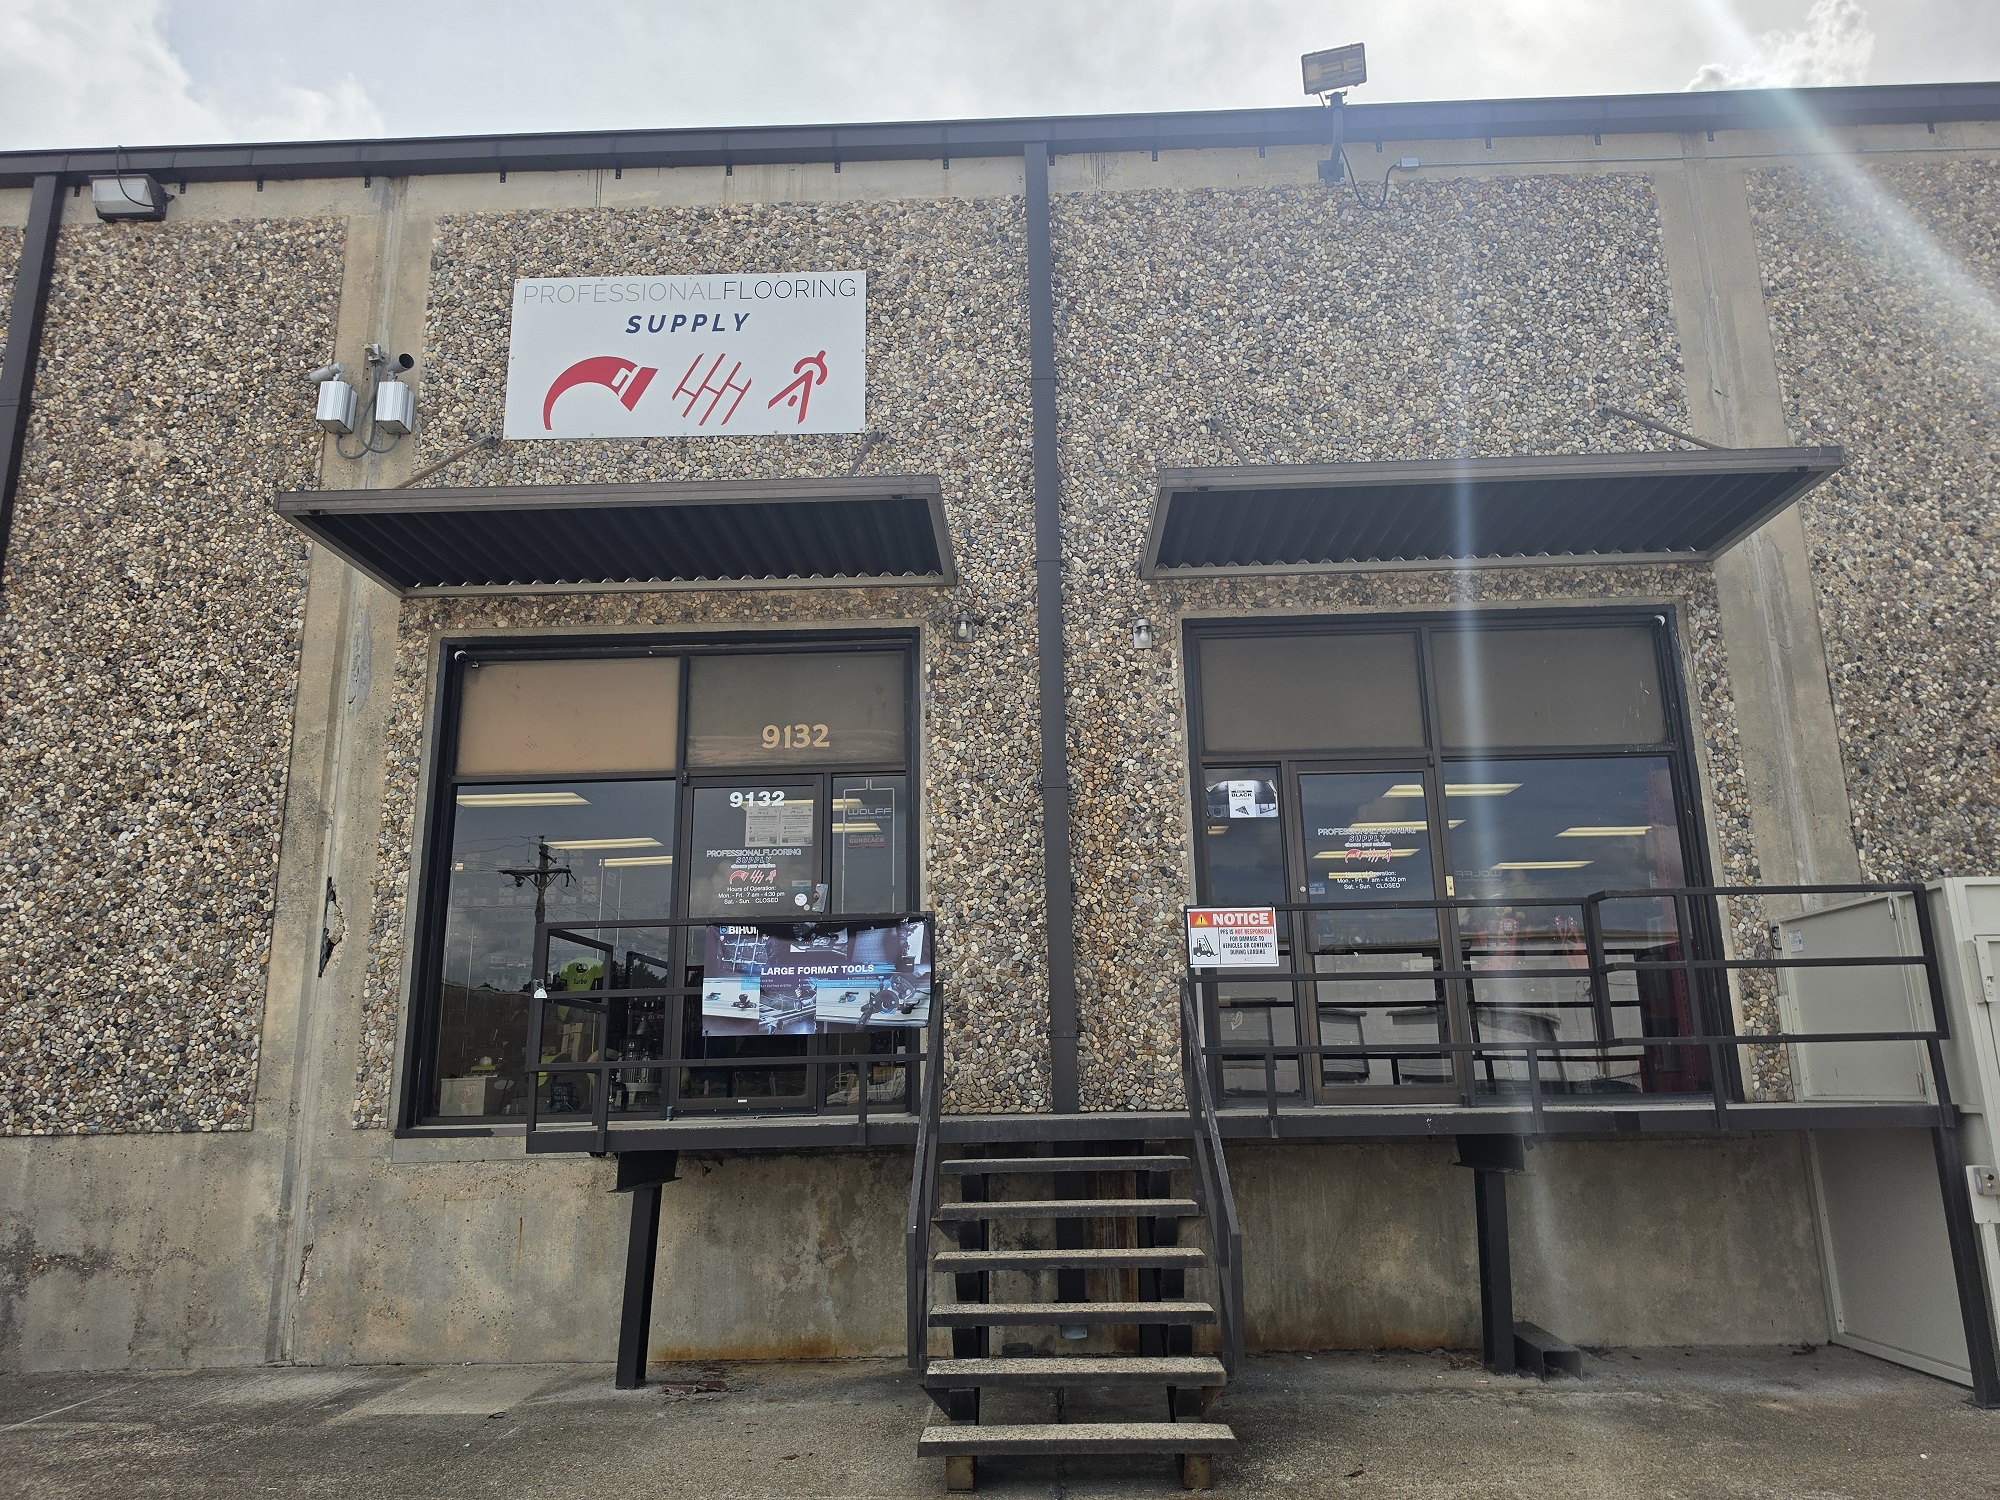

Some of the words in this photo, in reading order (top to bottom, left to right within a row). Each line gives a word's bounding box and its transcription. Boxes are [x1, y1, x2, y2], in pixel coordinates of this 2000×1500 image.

[625, 312, 751, 334] SUPPLY
[761, 723, 831, 749] 9132
[729, 790, 785, 807] 9132
[847, 807, 892, 816] WOLFF
[1212, 912, 1270, 926] NOTICE
[728, 925, 757, 935] BIHUI
[760, 966, 795, 976] LARGE
[797, 965, 839, 975] FORMAT
[840, 964, 875, 974] TOOLS
